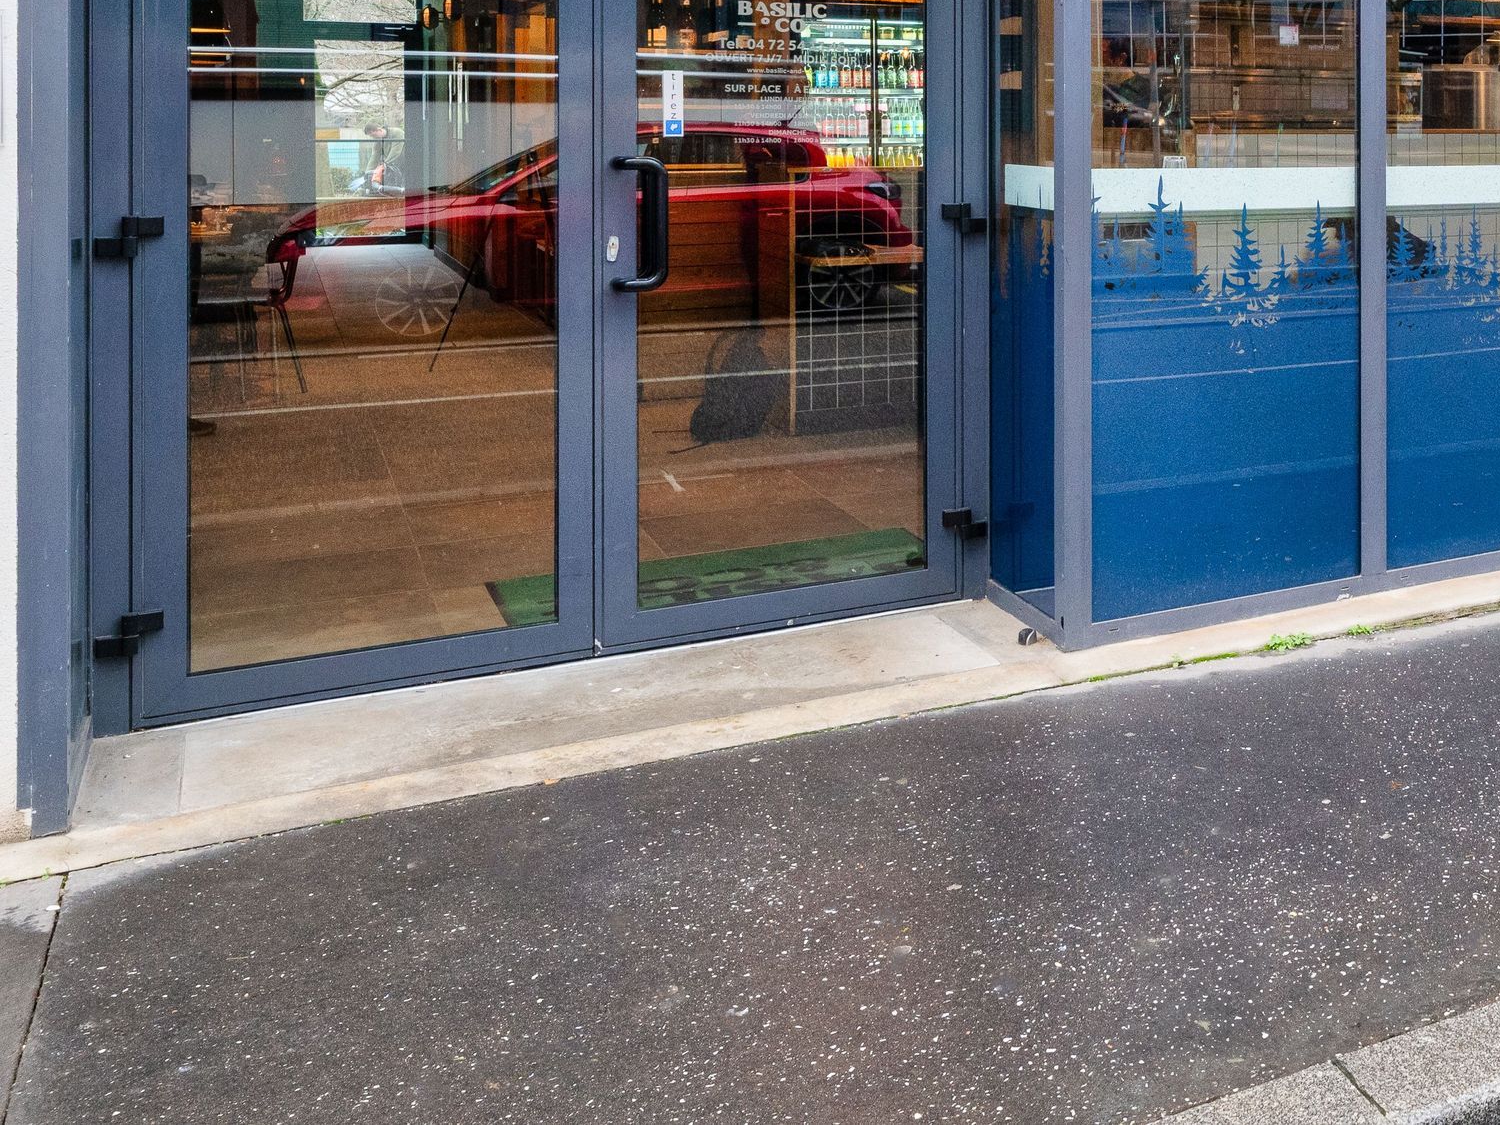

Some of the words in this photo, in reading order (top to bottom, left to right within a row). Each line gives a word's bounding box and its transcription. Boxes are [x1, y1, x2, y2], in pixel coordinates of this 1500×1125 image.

[737, 0, 828, 19] BASILIC
[775, 18, 805, 33] CO
[747, 39, 765, 50] 04
[768, 40, 785, 51] 72
[788, 40, 805, 51] 54
[705, 52, 754, 62] OUVERT
[724, 84, 746, 92] SUR
[748, 85, 781, 93] PLACE
[794, 83, 803, 93] À
